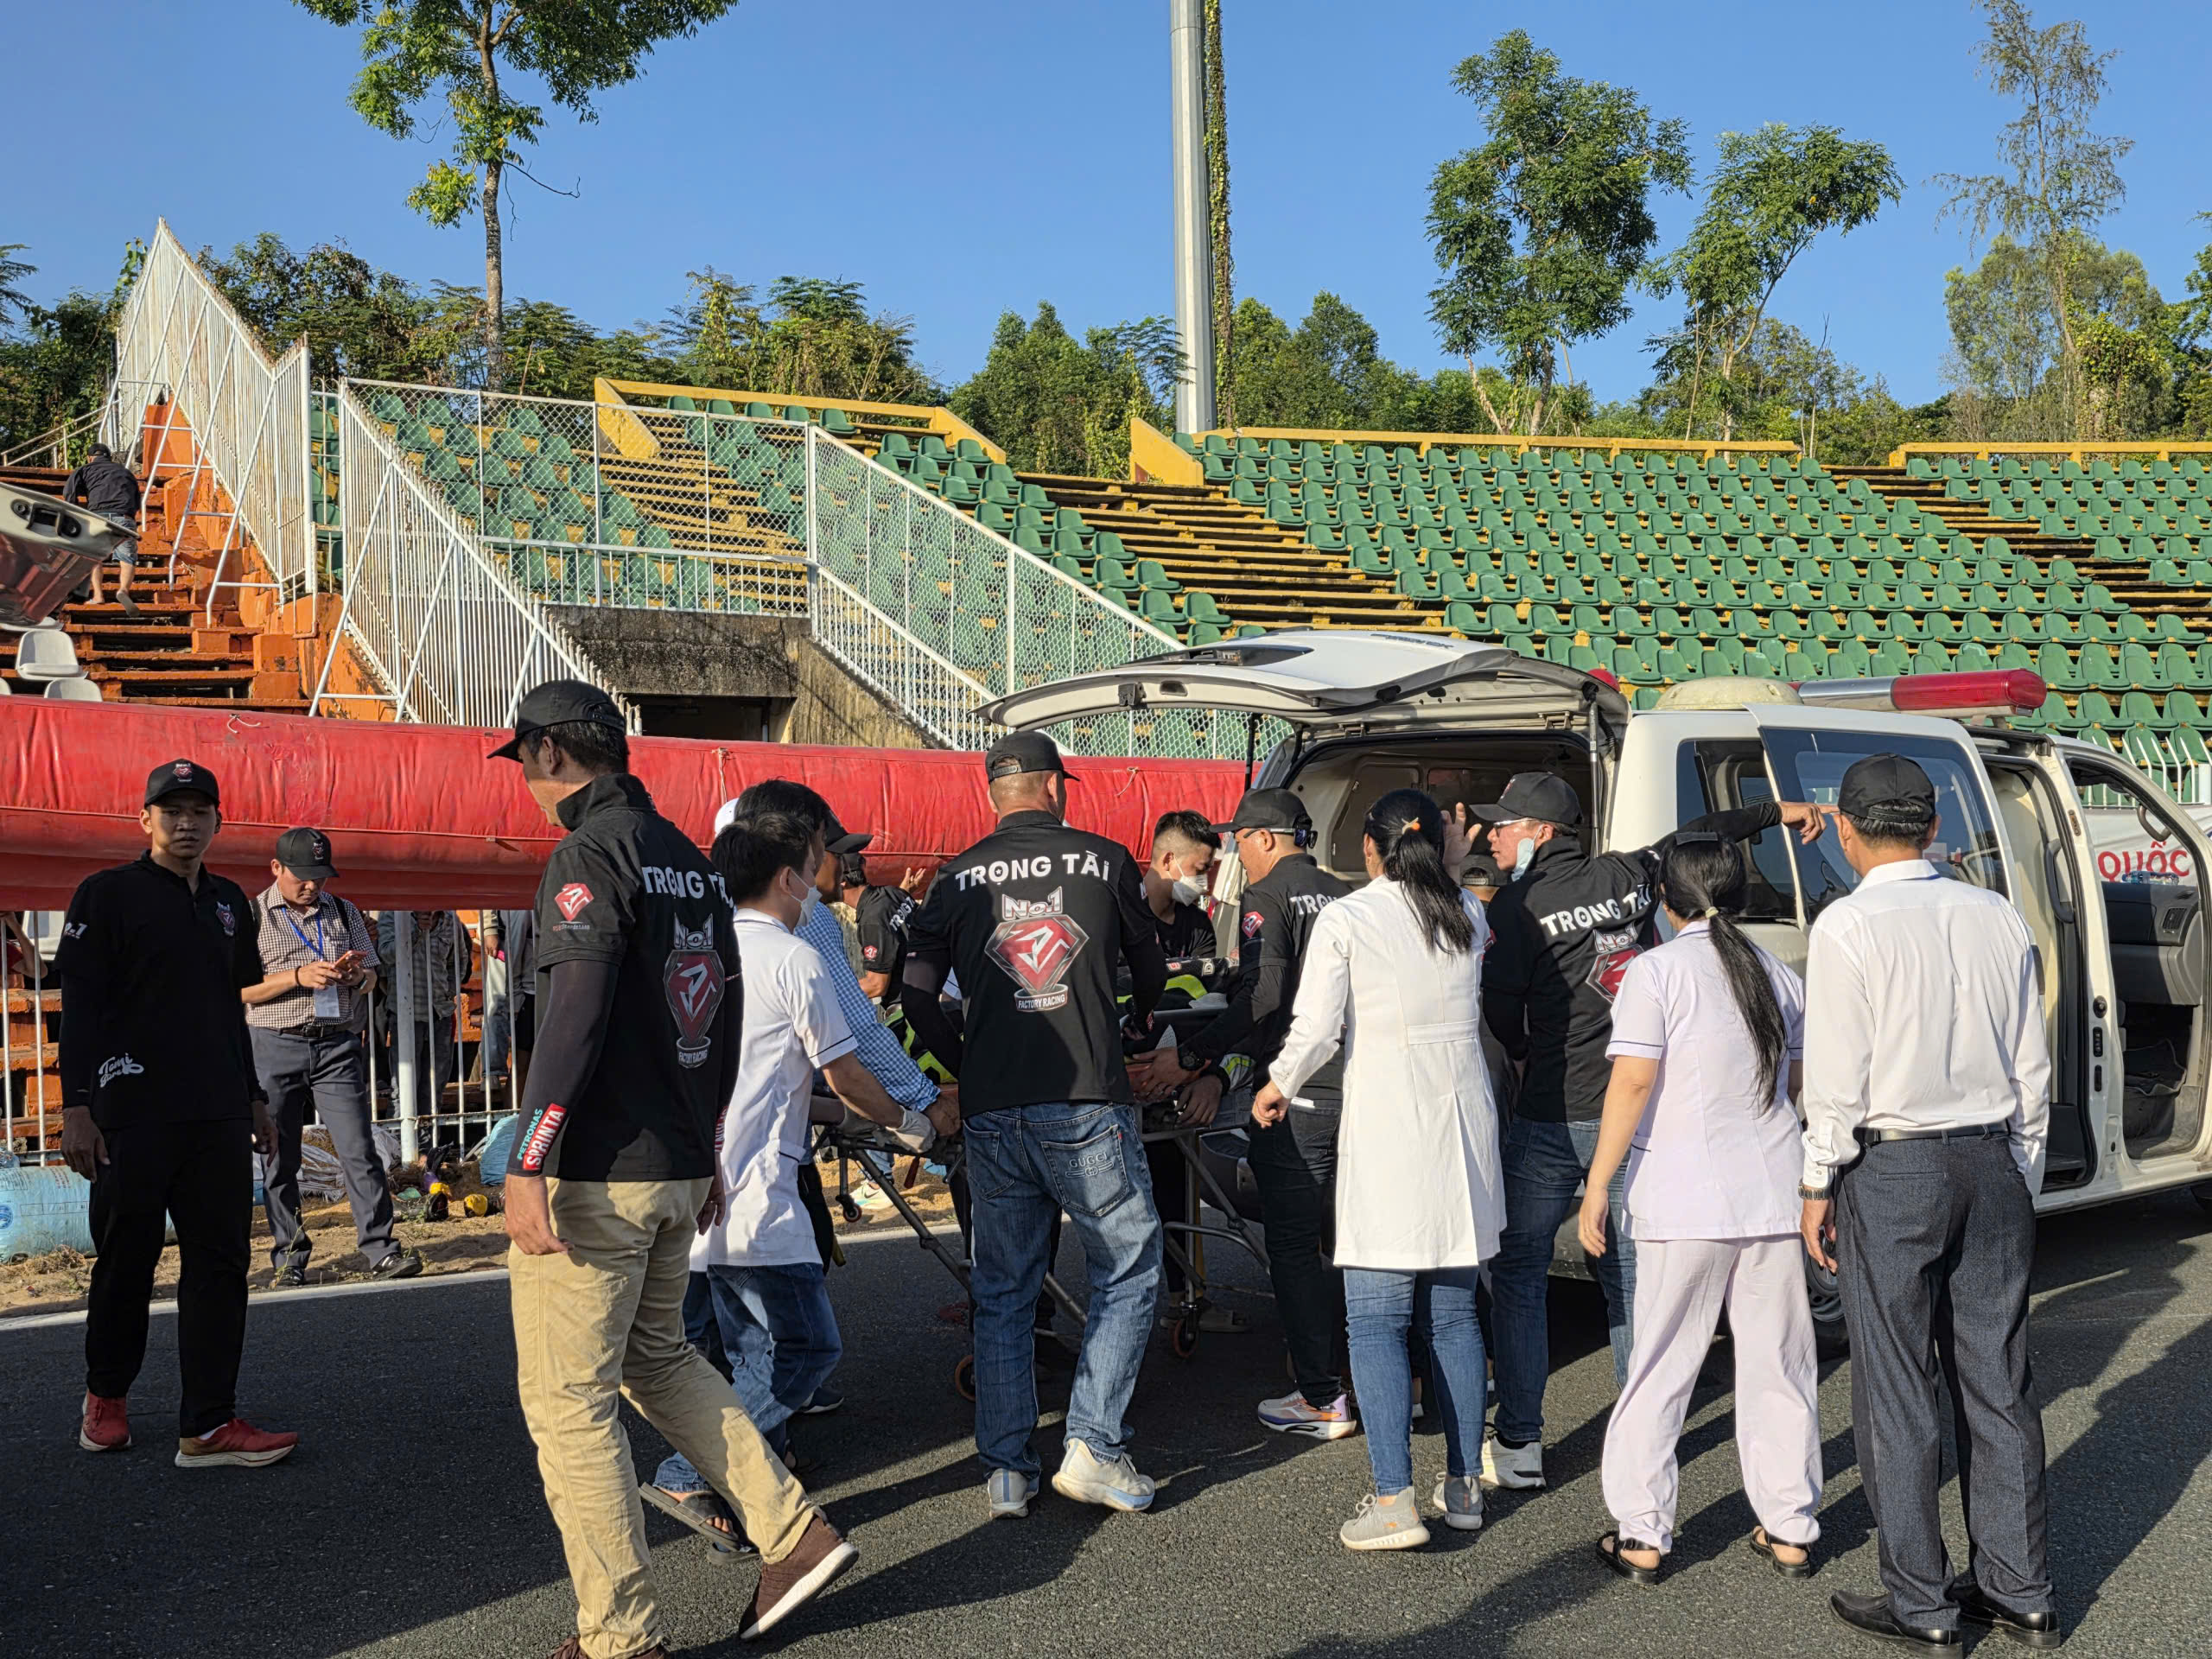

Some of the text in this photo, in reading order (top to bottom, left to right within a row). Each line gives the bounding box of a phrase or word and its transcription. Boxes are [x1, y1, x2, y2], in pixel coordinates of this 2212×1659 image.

[956, 855, 1052, 892] TRỌNG
[517, 1109, 543, 1160] PETRONAS
[526, 1109, 564, 1166] SPRINTA
[1069, 1152, 1108, 1168] GUCCI
